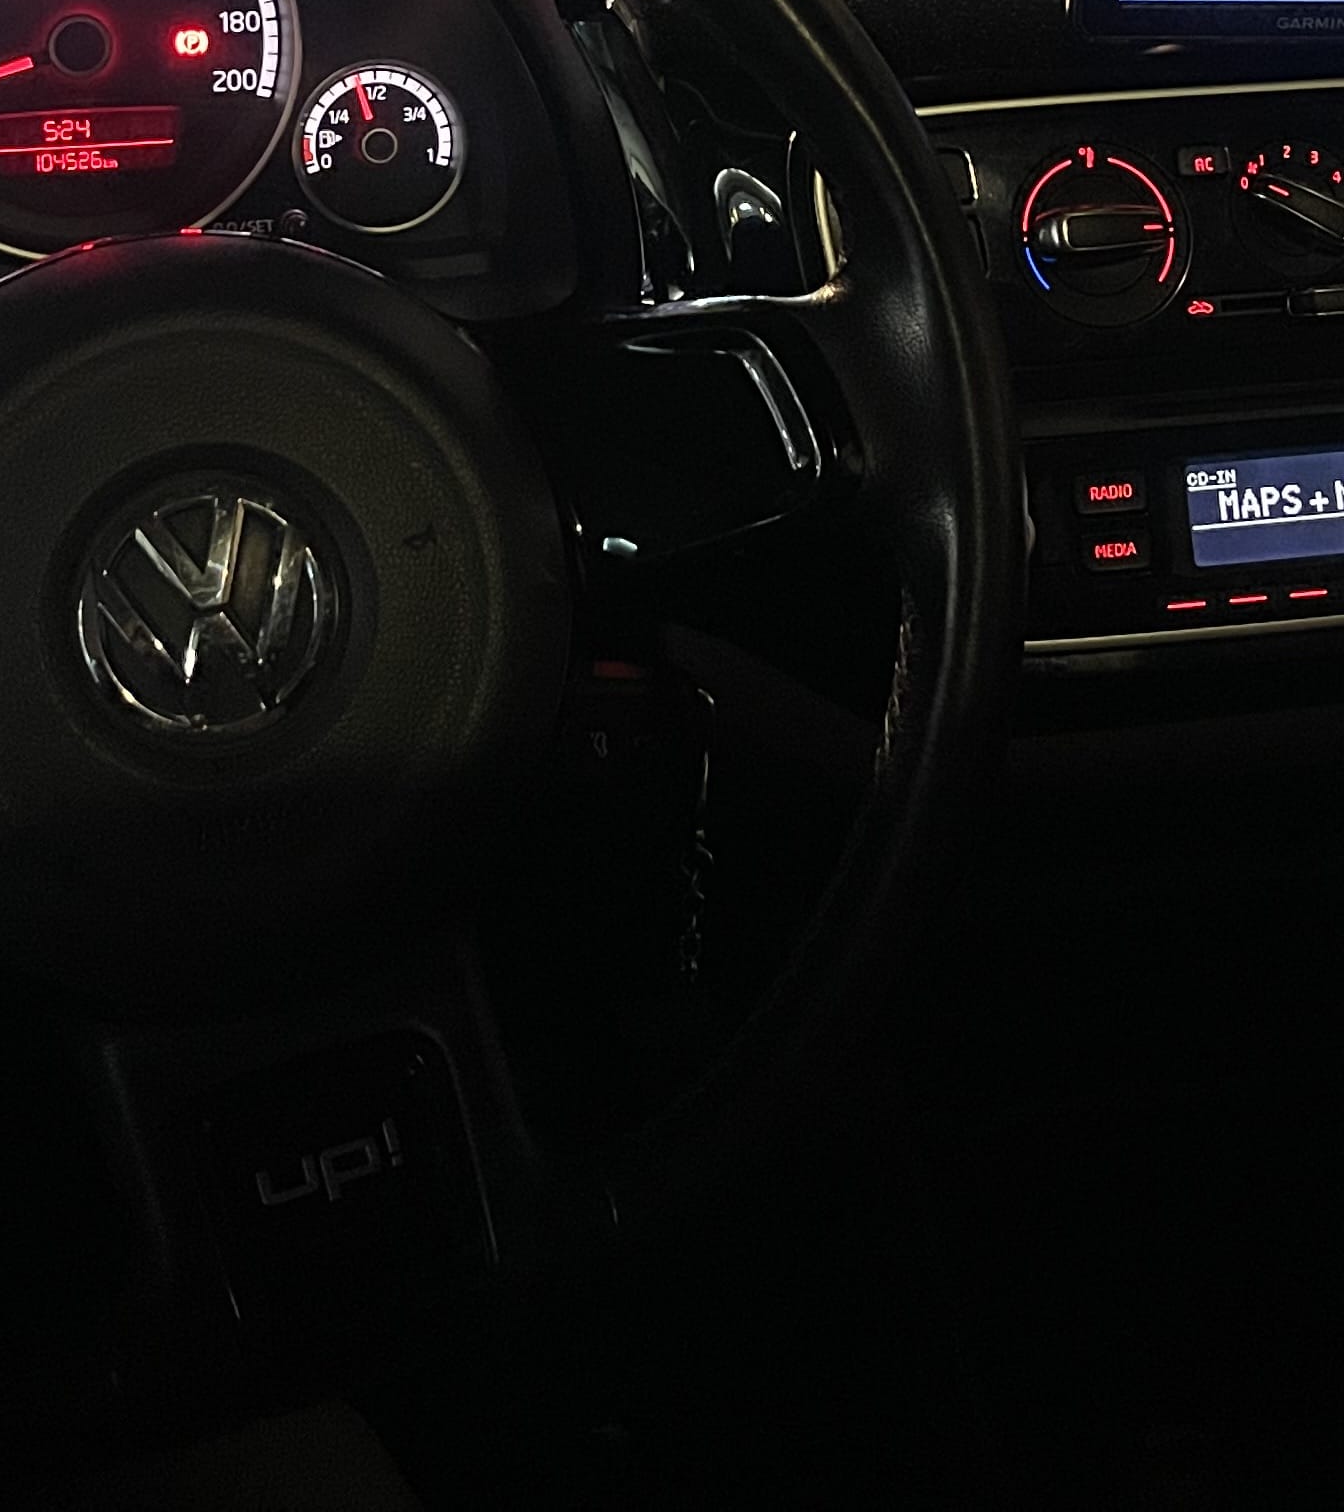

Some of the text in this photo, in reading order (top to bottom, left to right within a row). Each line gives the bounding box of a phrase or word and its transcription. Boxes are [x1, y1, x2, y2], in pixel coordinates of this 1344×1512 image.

[218, 10, 261, 34] 180
[212, 69, 257, 93] 200
[365, 85, 387, 101] 1/2
[328, 108, 351, 125] 1/4
[402, 106, 427, 123] 3/4
[321, 153, 332, 169] 0
[426, 148, 435, 163] 1
[1194, 157, 1214, 172] AC
[1240, 145, 1342, 190] 0 1 2 3 4
[1186, 469, 1237, 487] CD-IN
[1089, 483, 1133, 501] RADIO
[1217, 484, 1303, 521] MAPS
[1309, 490, 1329, 512] +
[1094, 541, 1137, 559] MEDIA
[256, 1117, 403, 1205] up!
